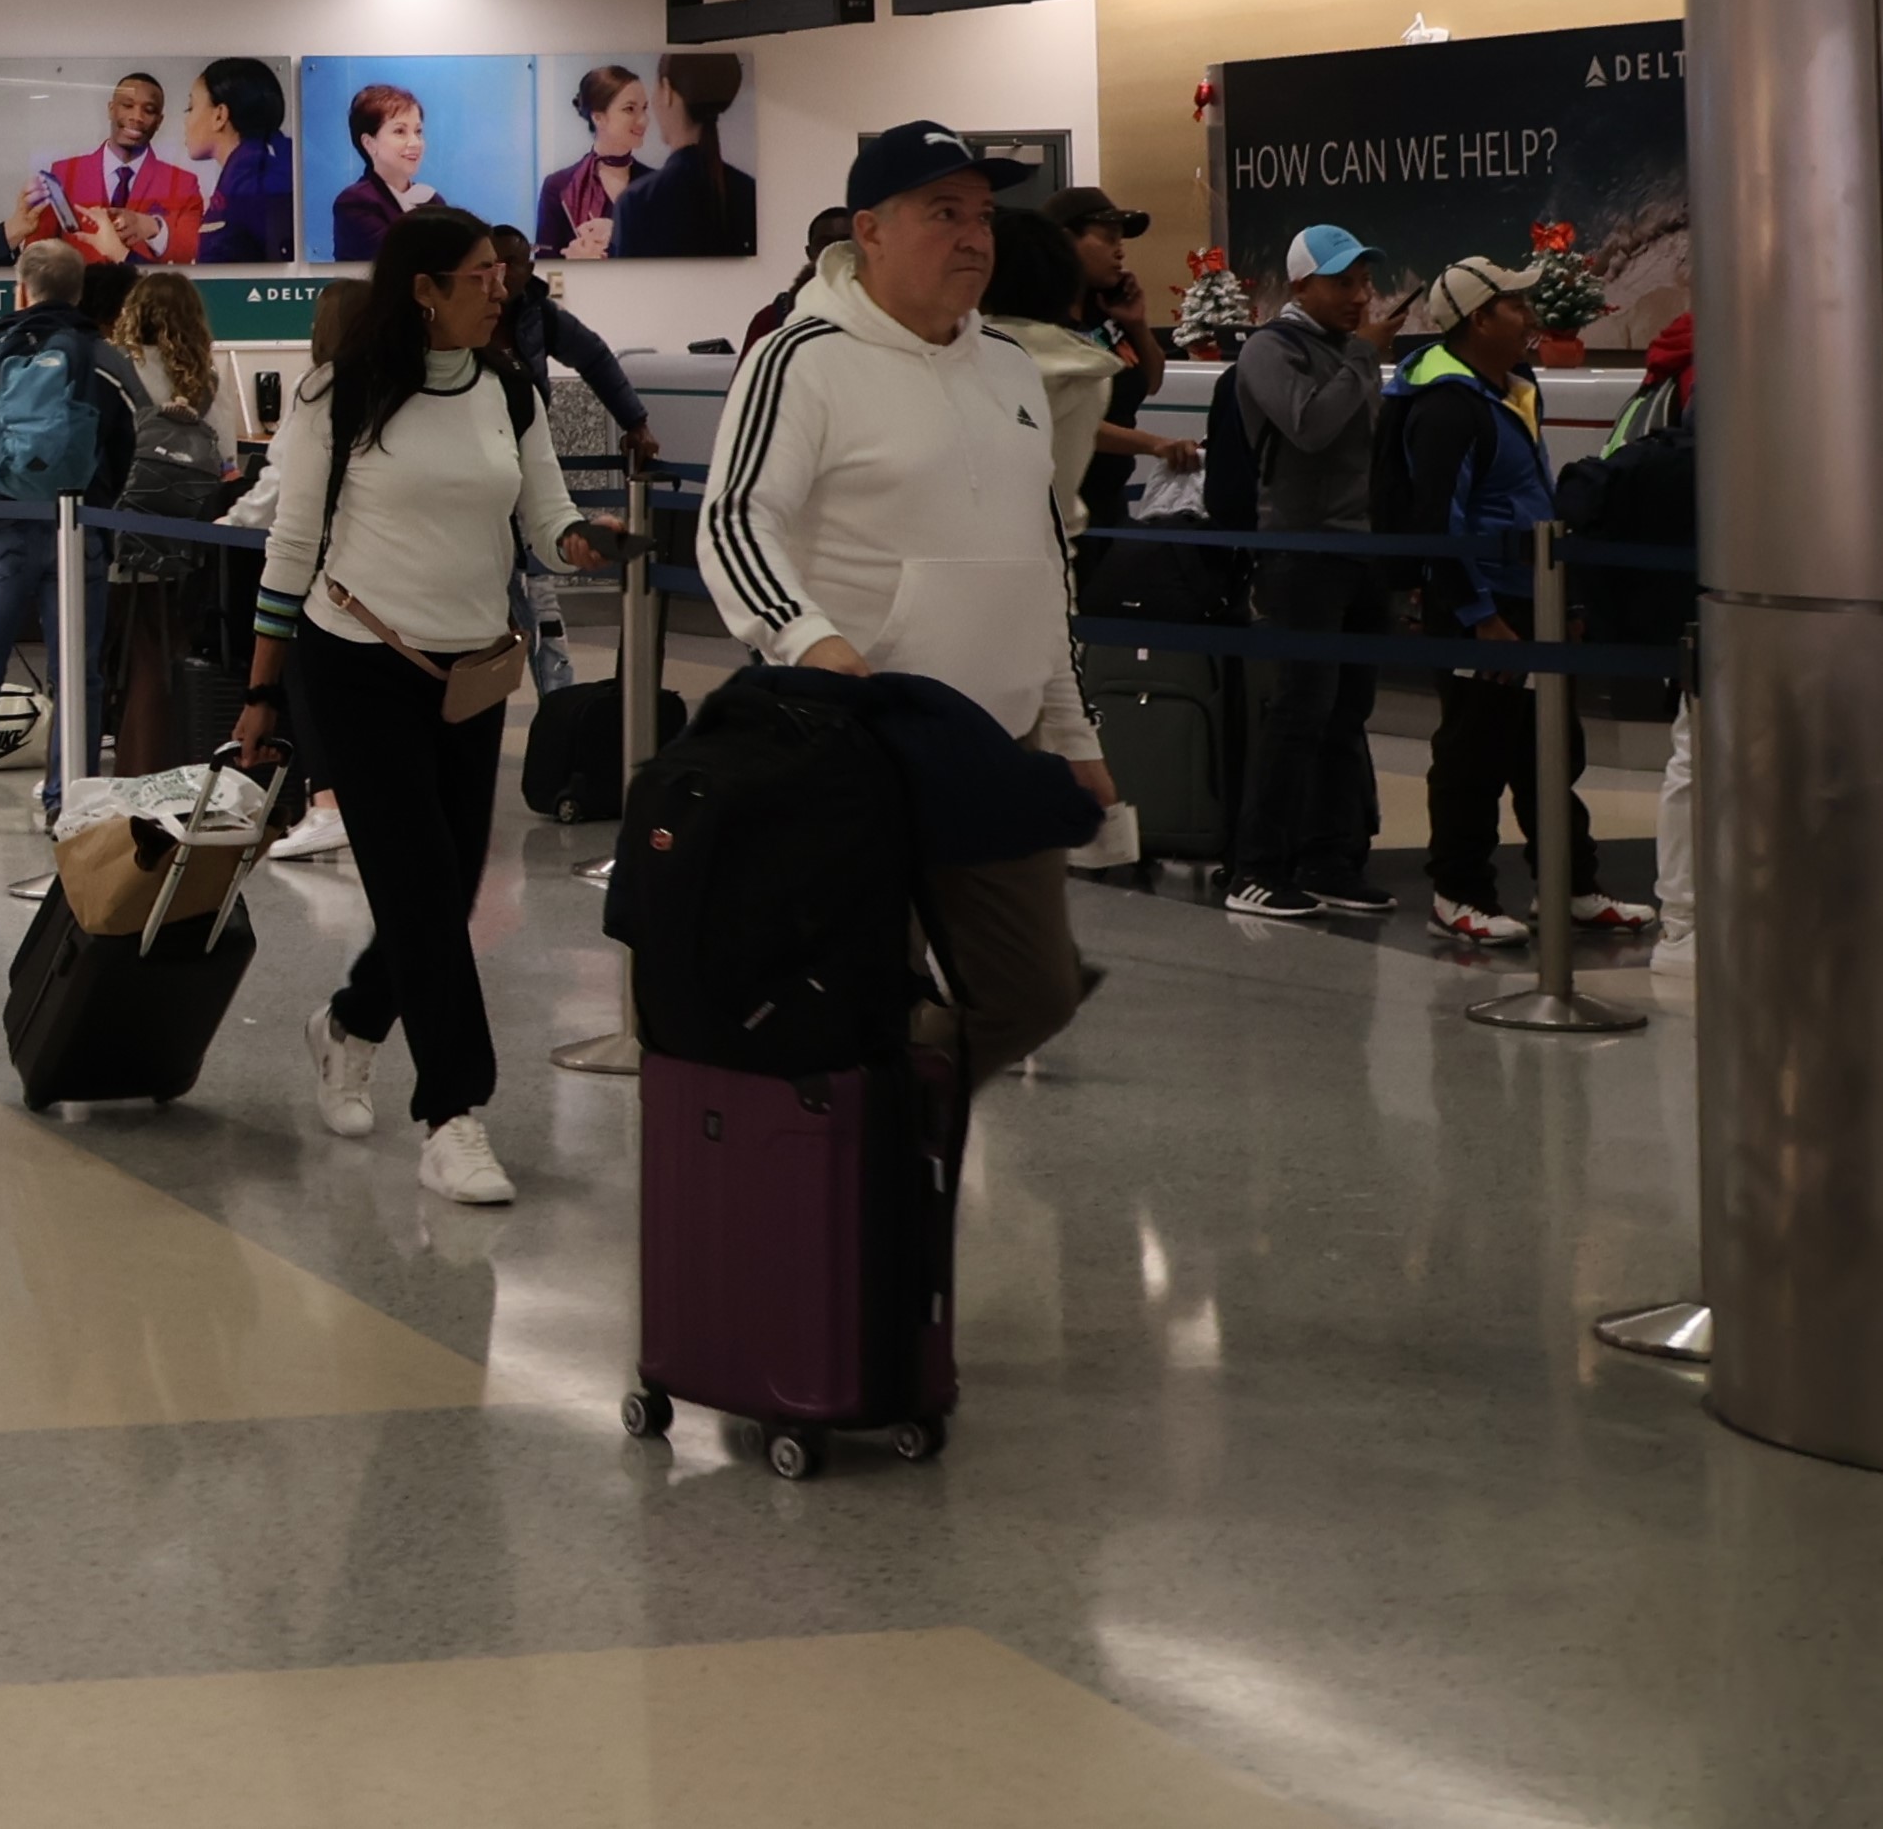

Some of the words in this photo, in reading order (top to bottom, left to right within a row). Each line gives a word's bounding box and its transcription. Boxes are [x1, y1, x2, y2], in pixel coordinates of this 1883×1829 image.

[1235, 143, 1310, 189] HOW
[1320, 138, 1386, 186] CAN
[1396, 134, 1448, 181] WE
[1459, 127, 1558, 178] HELP?
